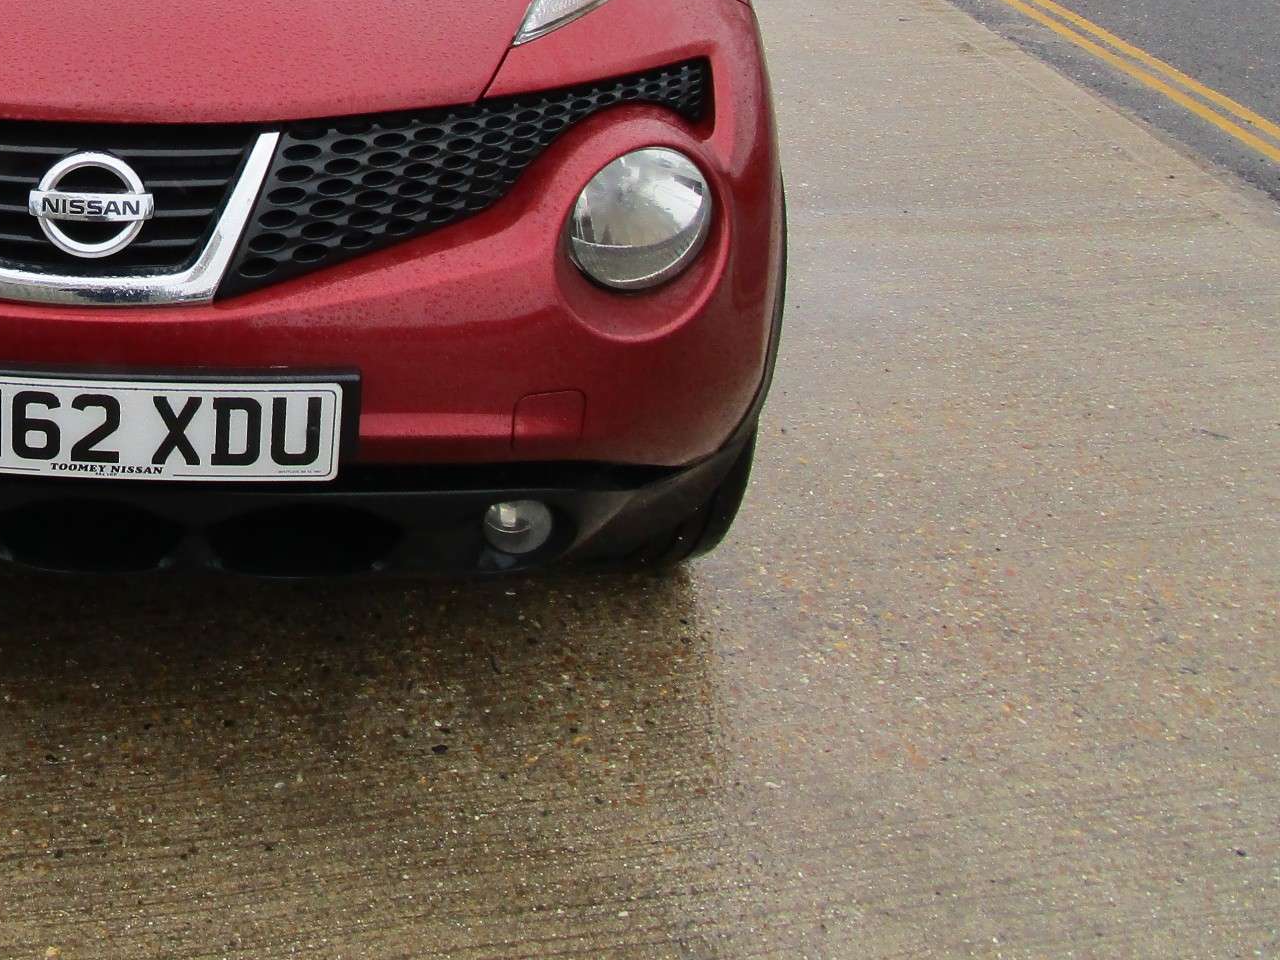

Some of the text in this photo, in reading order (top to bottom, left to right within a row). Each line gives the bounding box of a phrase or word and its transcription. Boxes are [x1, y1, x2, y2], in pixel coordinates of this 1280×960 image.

[41, 197, 141, 216] NISSAN
[151, 395, 324, 467] XDU
[50, 462, 107, 474] TOOMEY
[110, 465, 164, 476] NISSAN
